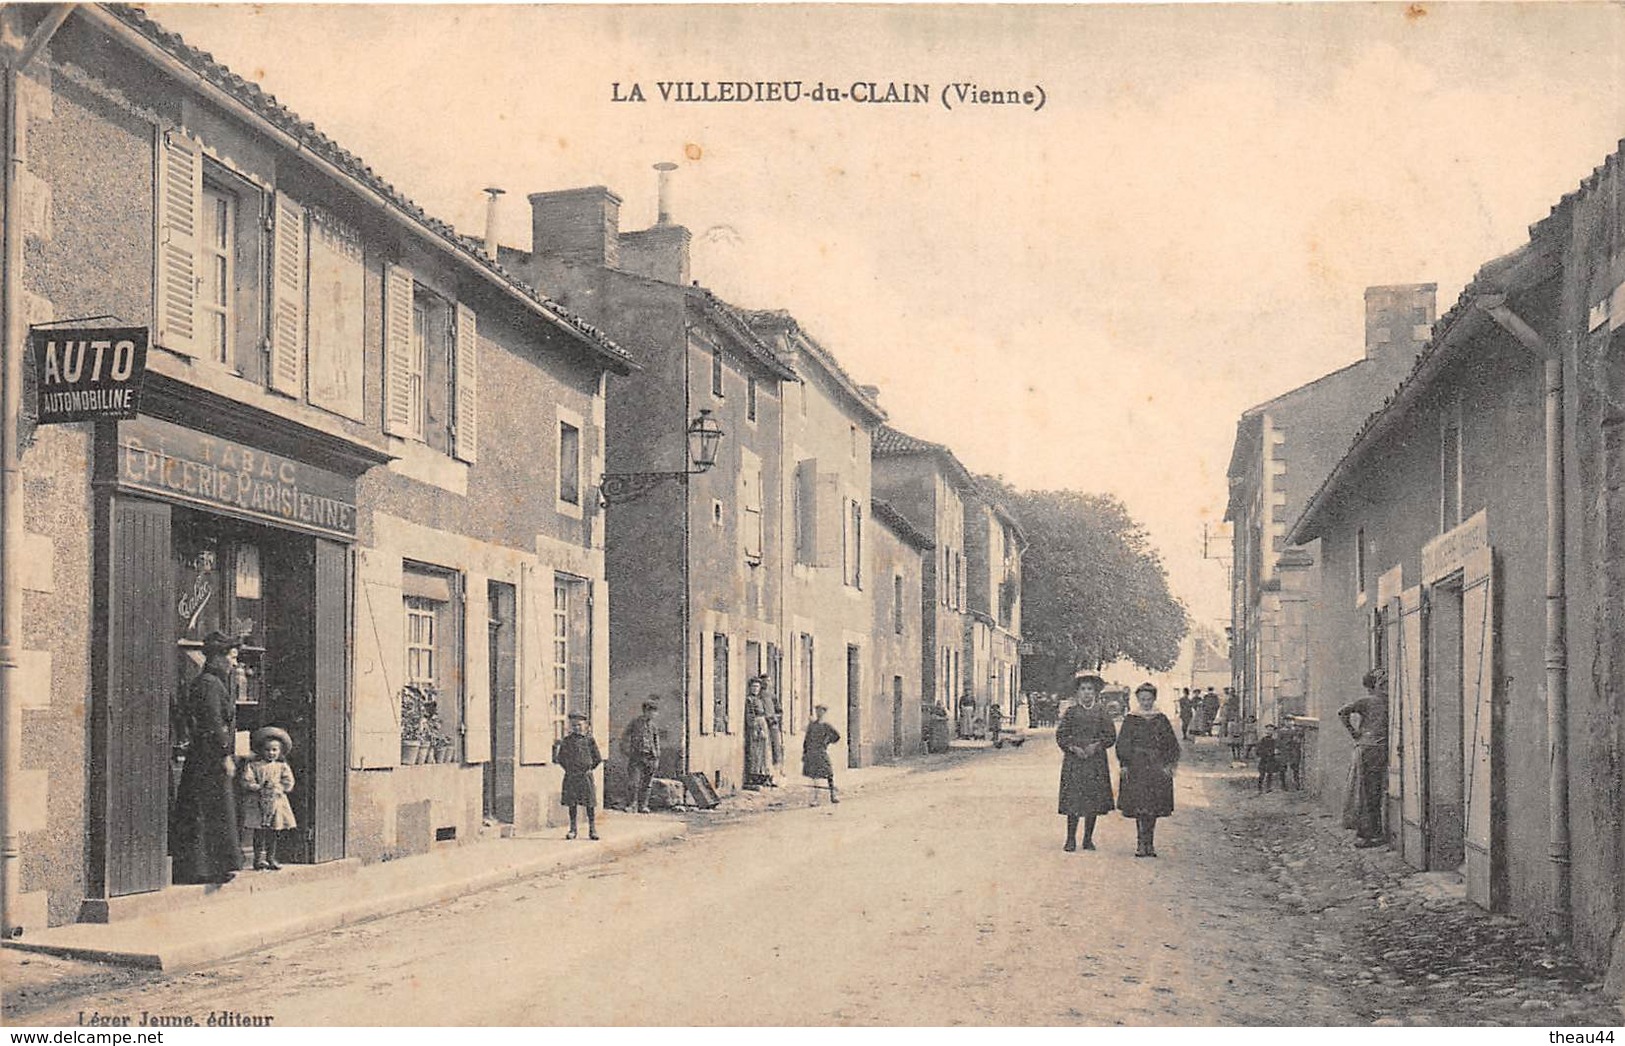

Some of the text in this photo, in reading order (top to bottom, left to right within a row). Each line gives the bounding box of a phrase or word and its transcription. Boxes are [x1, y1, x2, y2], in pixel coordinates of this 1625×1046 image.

[45, 340, 135, 384] AUTO
[44, 388, 133, 413] AUTOMOBILINE
[201, 438, 296, 484] TABAC
[234, 469, 354, 531] PARISIENNE
